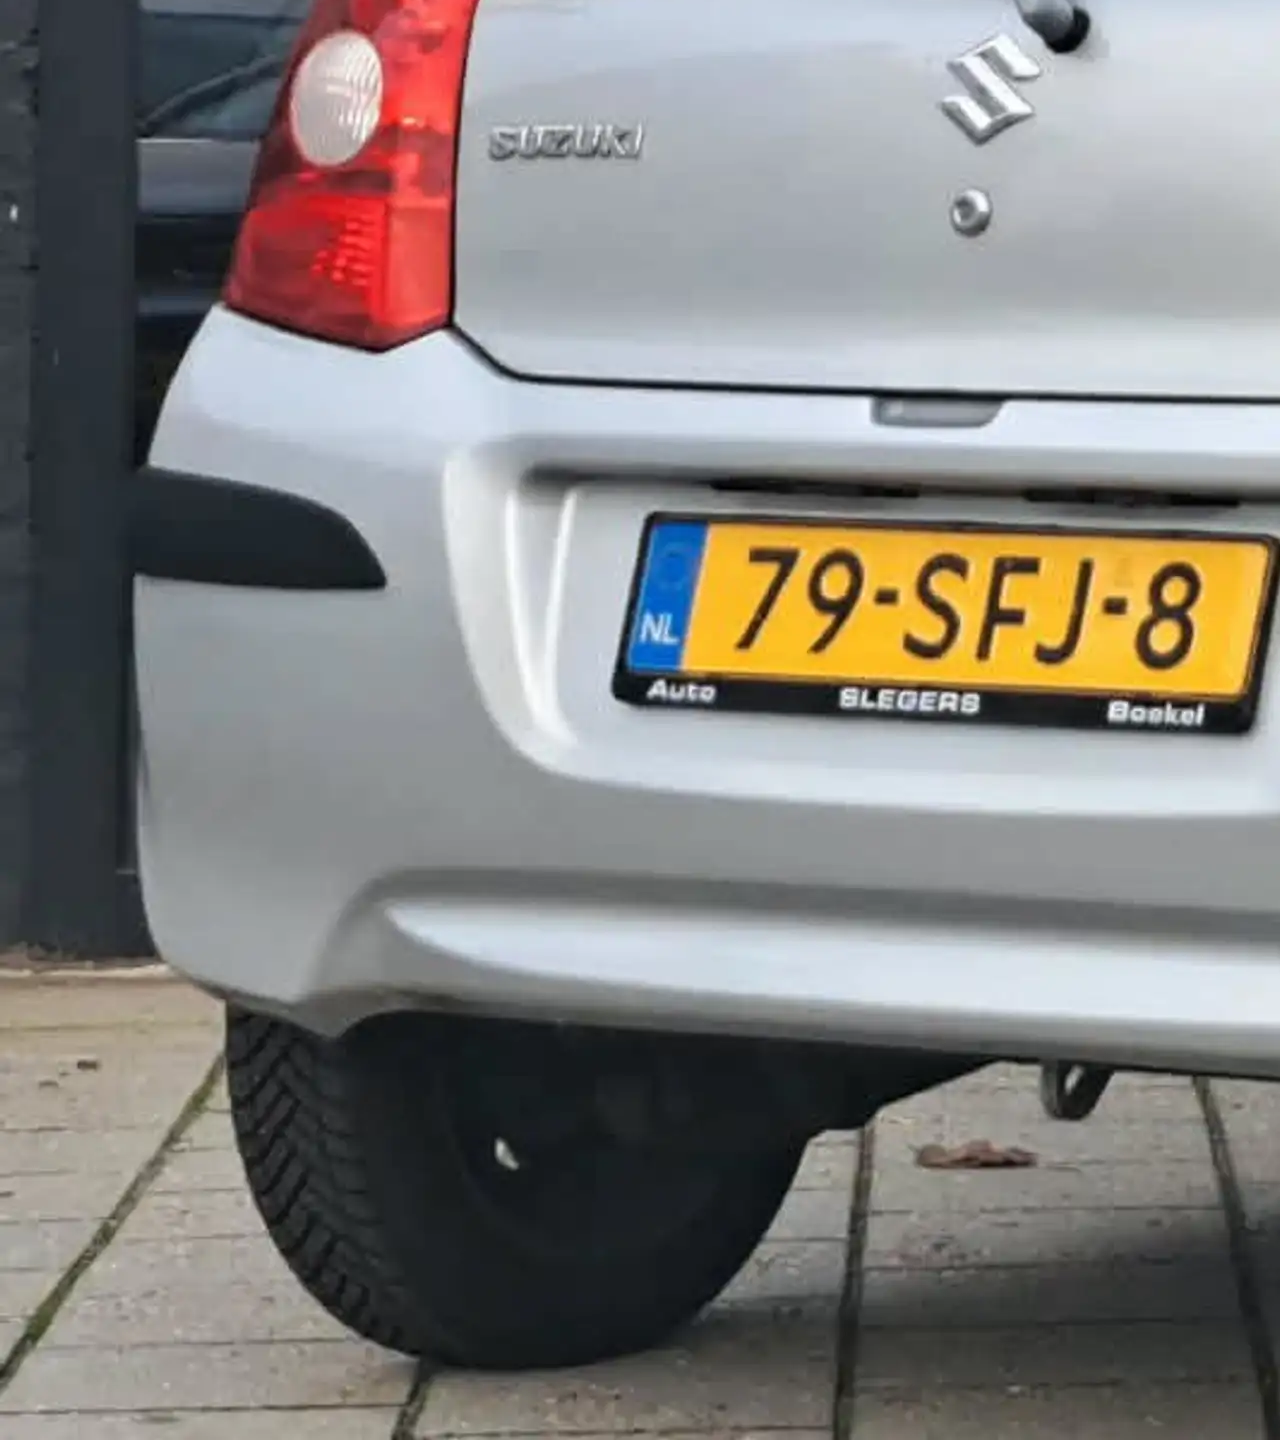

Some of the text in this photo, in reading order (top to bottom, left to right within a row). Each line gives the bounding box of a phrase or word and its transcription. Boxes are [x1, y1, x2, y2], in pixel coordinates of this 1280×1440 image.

[490, 124, 646, 161] SUZUKI
[640, 611, 680, 645] NL
[735, 546, 1202, 670] 79-SFJ-8
[646, 678, 1205, 727] Auto SLEGERS Boekel
